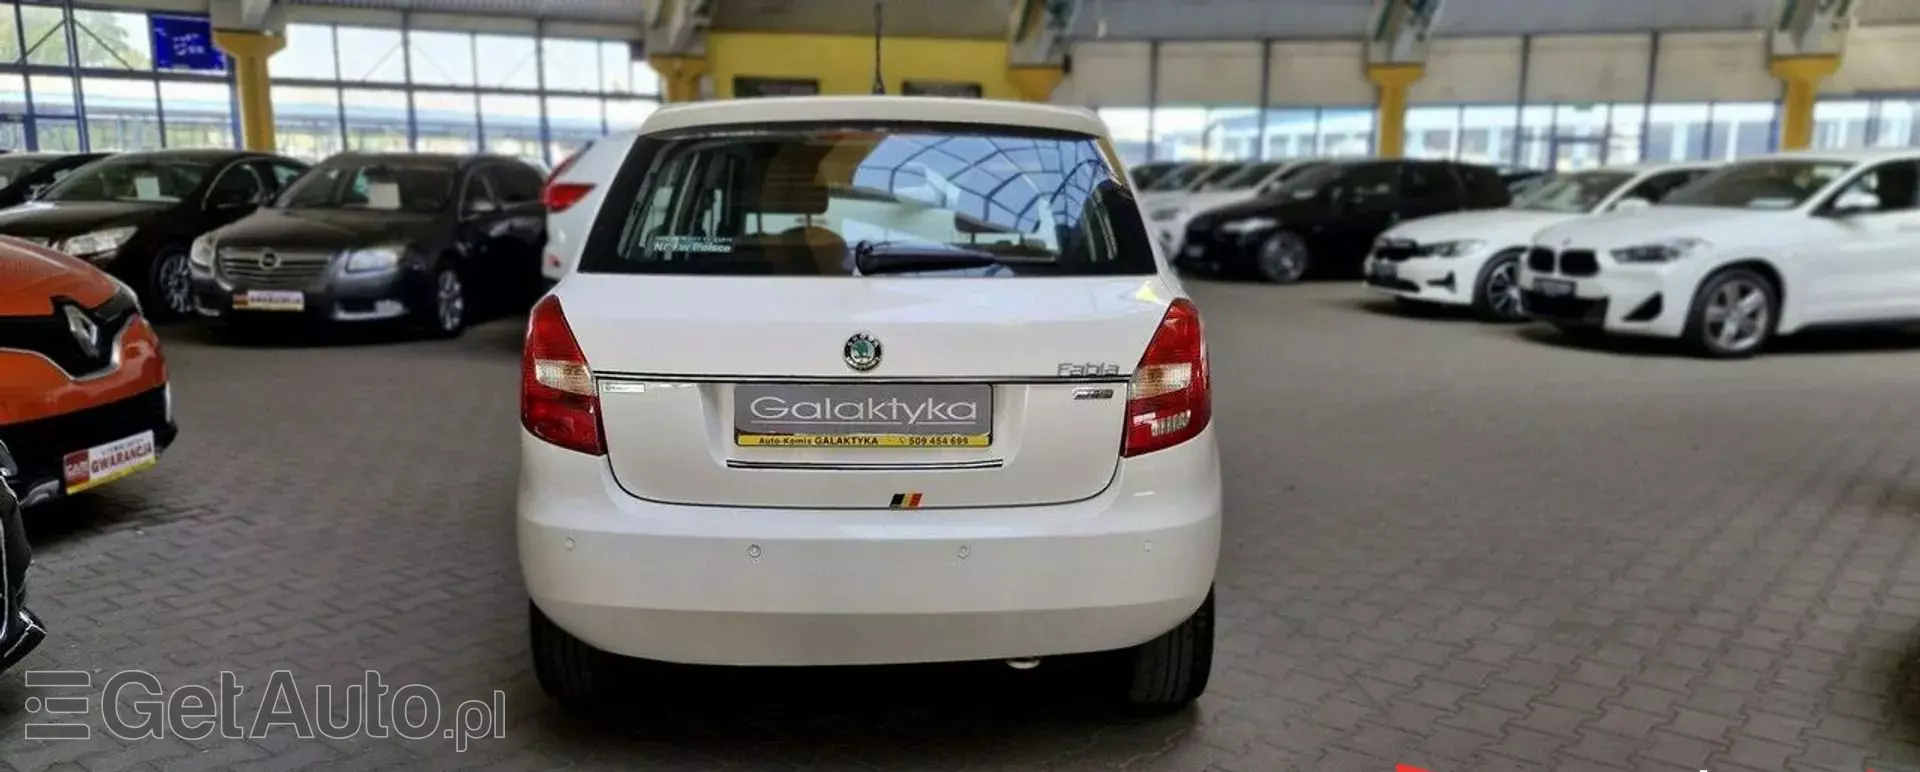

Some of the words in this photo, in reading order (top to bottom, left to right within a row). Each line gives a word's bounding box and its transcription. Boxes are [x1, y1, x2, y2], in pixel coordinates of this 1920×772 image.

[1057, 362, 1120, 376] Fabia
[750, 396, 977, 424] Galaktyka
[759, 436, 812, 445] Auto-Komis
[814, 436, 879, 445] GALAKTYKA
[909, 436, 927, 445] 509
[929, 436, 948, 445] 454
[91, 442, 153, 474] GWARANCJA
